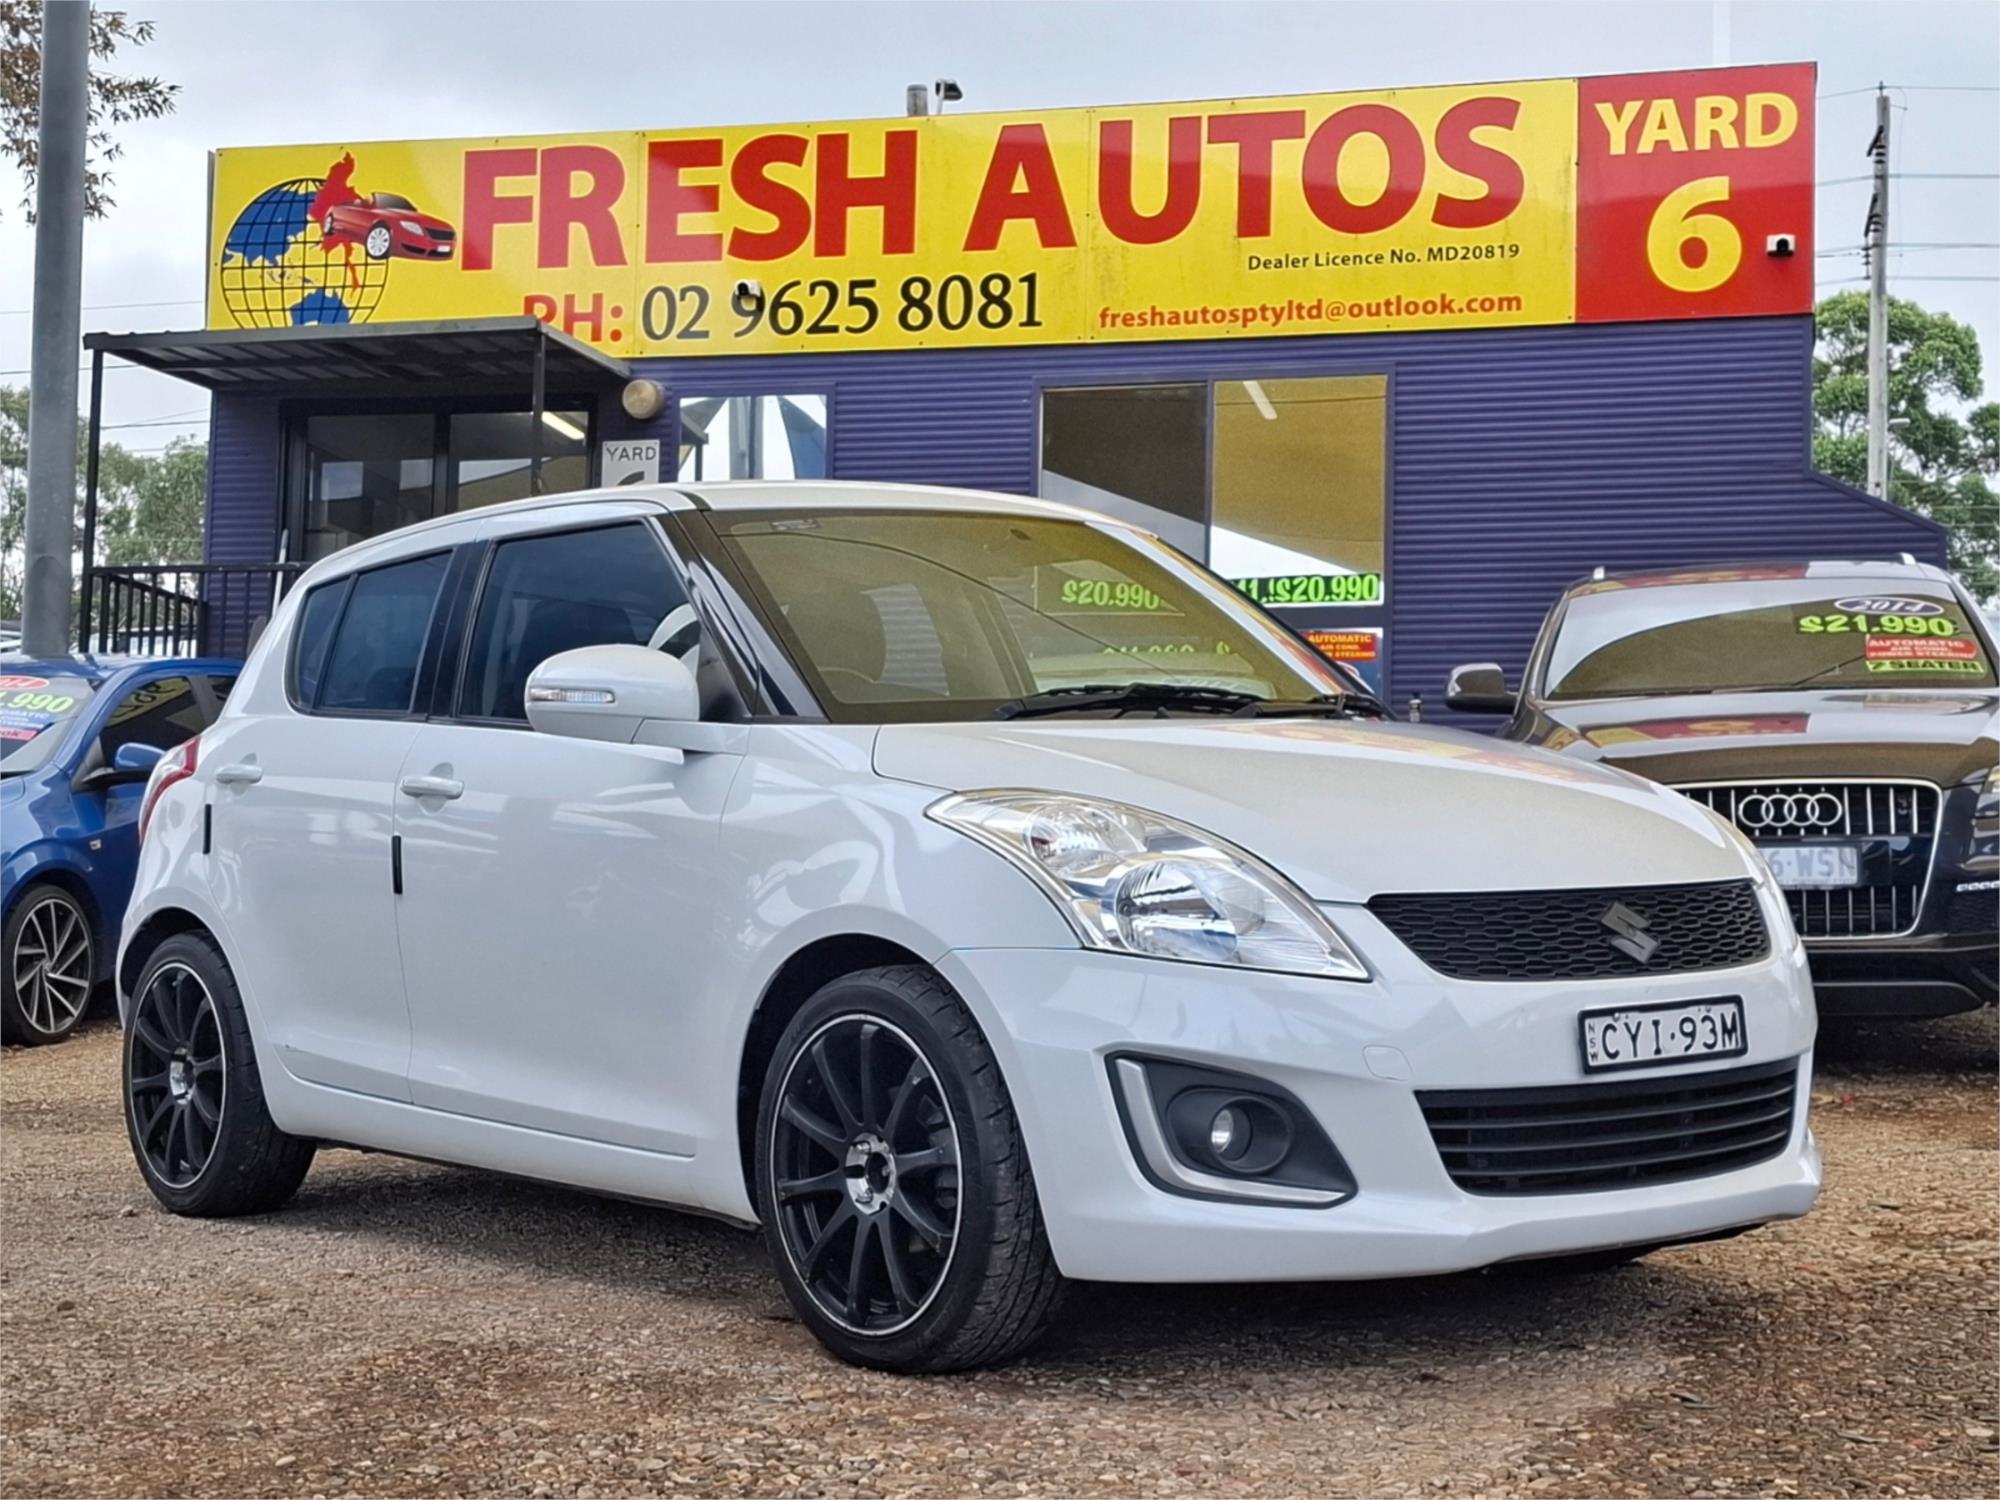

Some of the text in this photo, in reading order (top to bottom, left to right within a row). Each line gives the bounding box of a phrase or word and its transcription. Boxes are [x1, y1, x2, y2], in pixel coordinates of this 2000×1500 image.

[1594, 92, 1799, 155] YARD
[461, 97, 1525, 272] FRESH AUTOS
[1647, 175, 1742, 292] 6
[1248, 243, 1520, 270] Dealer Licence No. MD20819
[641, 285, 710, 340] 02
[731, 279, 879, 338] 9625
[897, 272, 1043, 332] 8081
[1099, 293, 1522, 328] freshautosptyltd@outlook.com
[606, 446, 656, 462] YARD
[1850, 599, 1925, 613] 2014
[1308, 634, 1372, 643] AUTOMATIC
[1799, 614, 1955, 636] $21.990
[1891, 661, 1978, 671] SEATER
